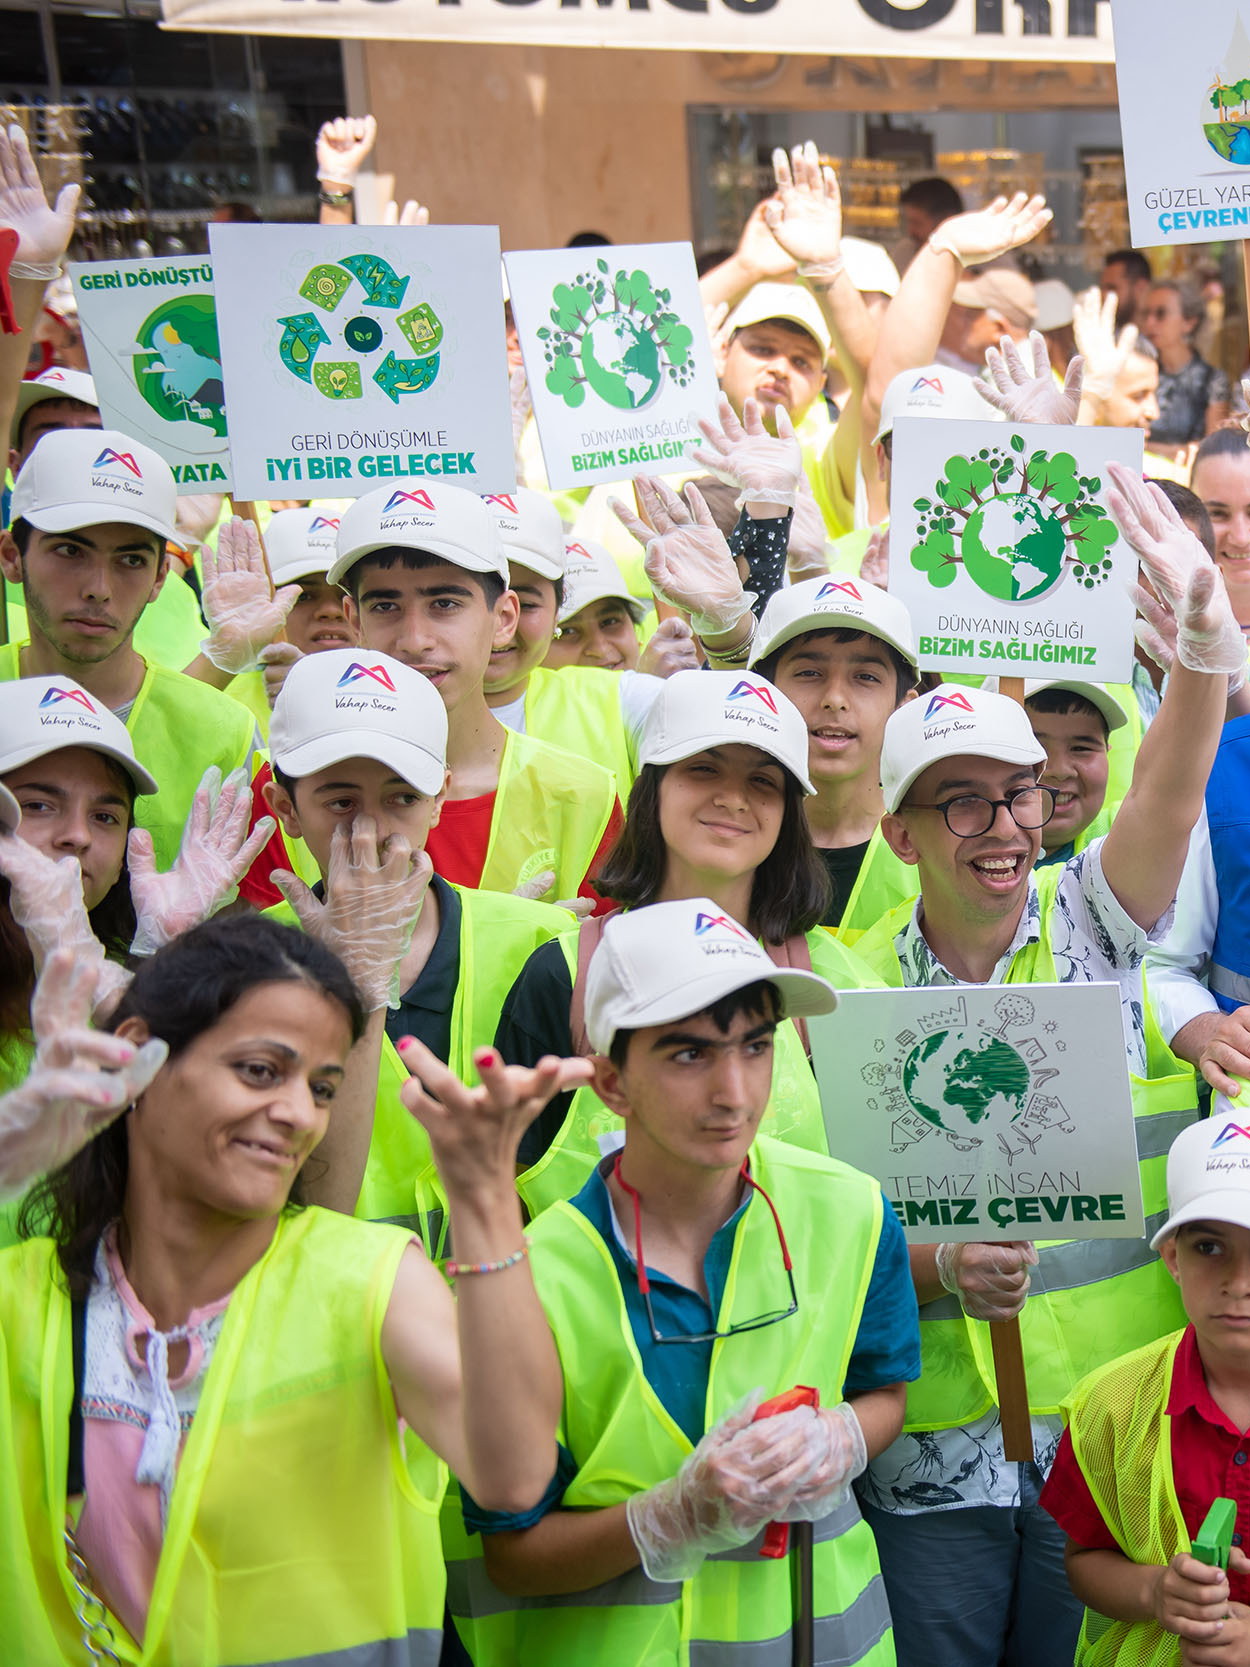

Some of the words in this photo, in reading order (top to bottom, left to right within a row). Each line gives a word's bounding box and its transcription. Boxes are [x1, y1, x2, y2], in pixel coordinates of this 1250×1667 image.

[1144, 188, 1210, 210] GÜZEL
[79, 270, 123, 291] GERİ
[291, 432, 333, 451] GERİ
[338, 430, 448, 450] DÖNÜŞÜMLE
[581, 426, 644, 448] DÜNYANIN
[646, 418, 690, 438] SAĞLIĞI
[358, 452, 478, 478] GELECEK
[938, 614, 1019, 635] DÜNYANIN
[1024, 619, 1084, 639] SAĞLIĞI
[978, 638, 1097, 666] SAĞLIĞIMIZ
[335, 696, 368, 712] Vahap
[924, 726, 951, 741] Vahap
[987, 1194, 1126, 1229] ÇEVRE
